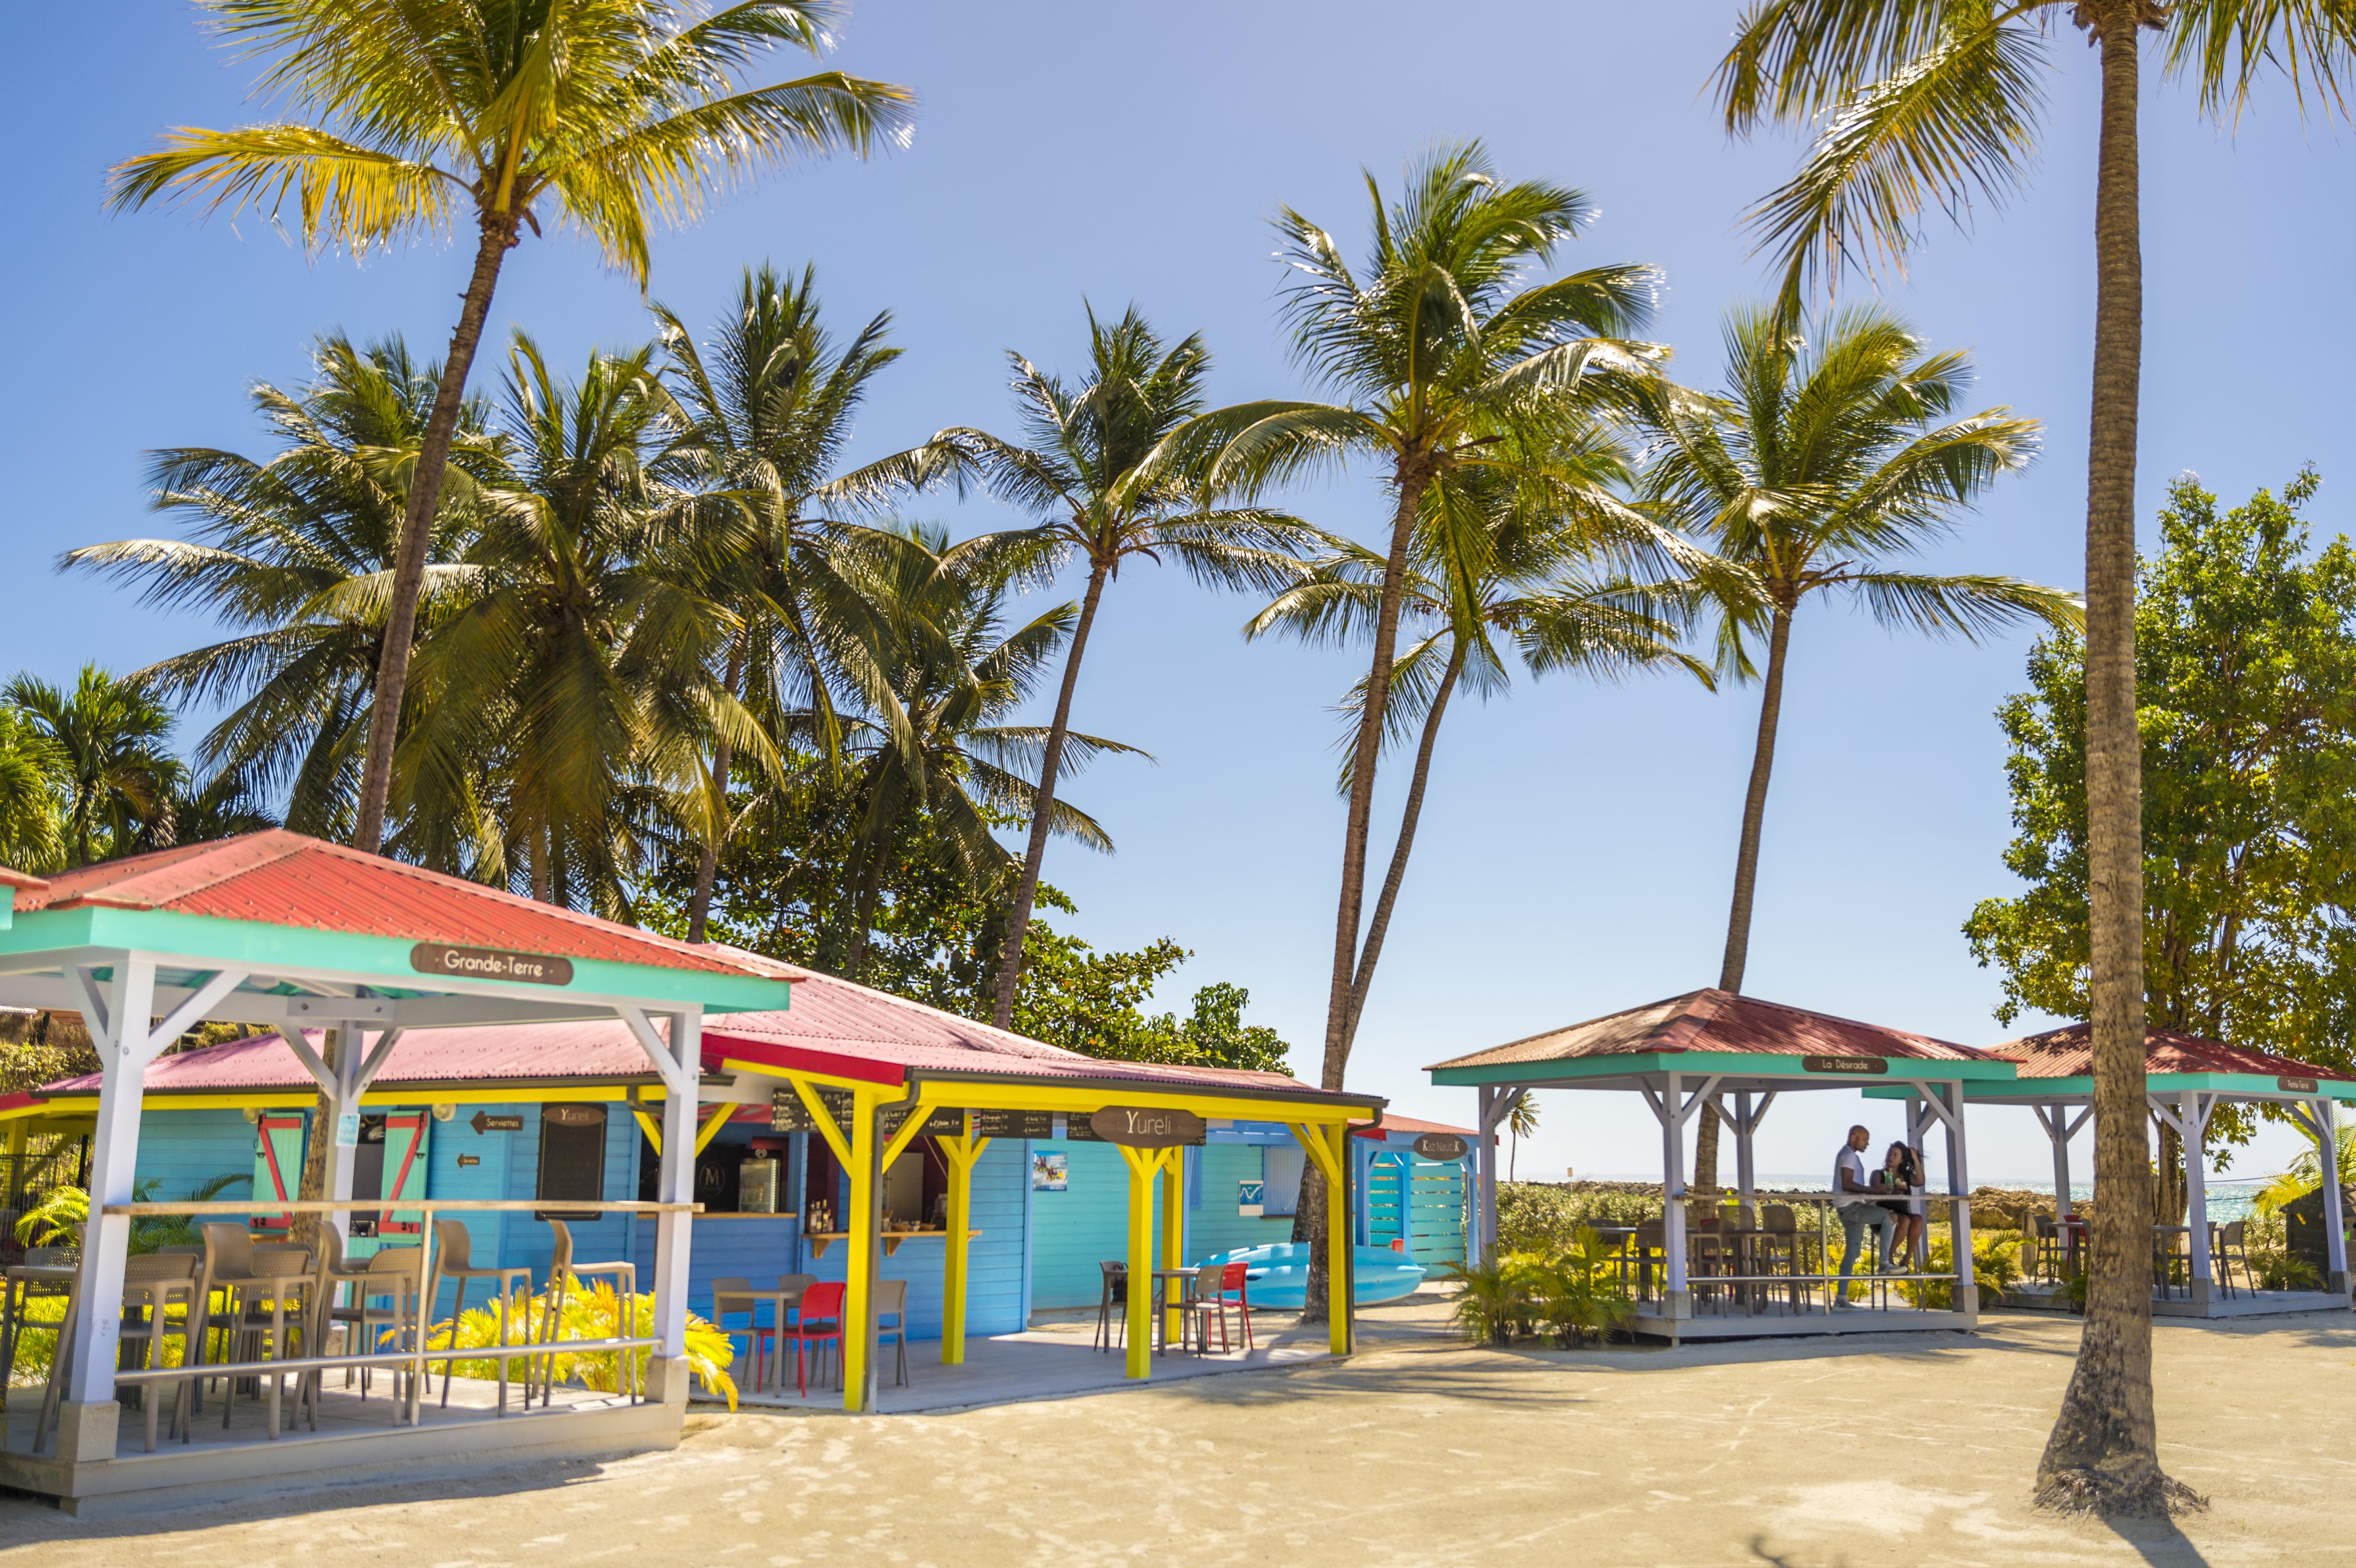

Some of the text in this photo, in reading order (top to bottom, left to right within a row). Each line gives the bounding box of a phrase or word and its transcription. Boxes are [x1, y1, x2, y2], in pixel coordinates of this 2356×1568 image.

[444, 949, 543, 977] Grande-Terre
[1822, 1059, 1868, 1069] La Désirade
[561, 1108, 589, 1121] Yureli
[486, 1117, 519, 1128] Serviettes
[1126, 1110, 1171, 1135] Yureli
